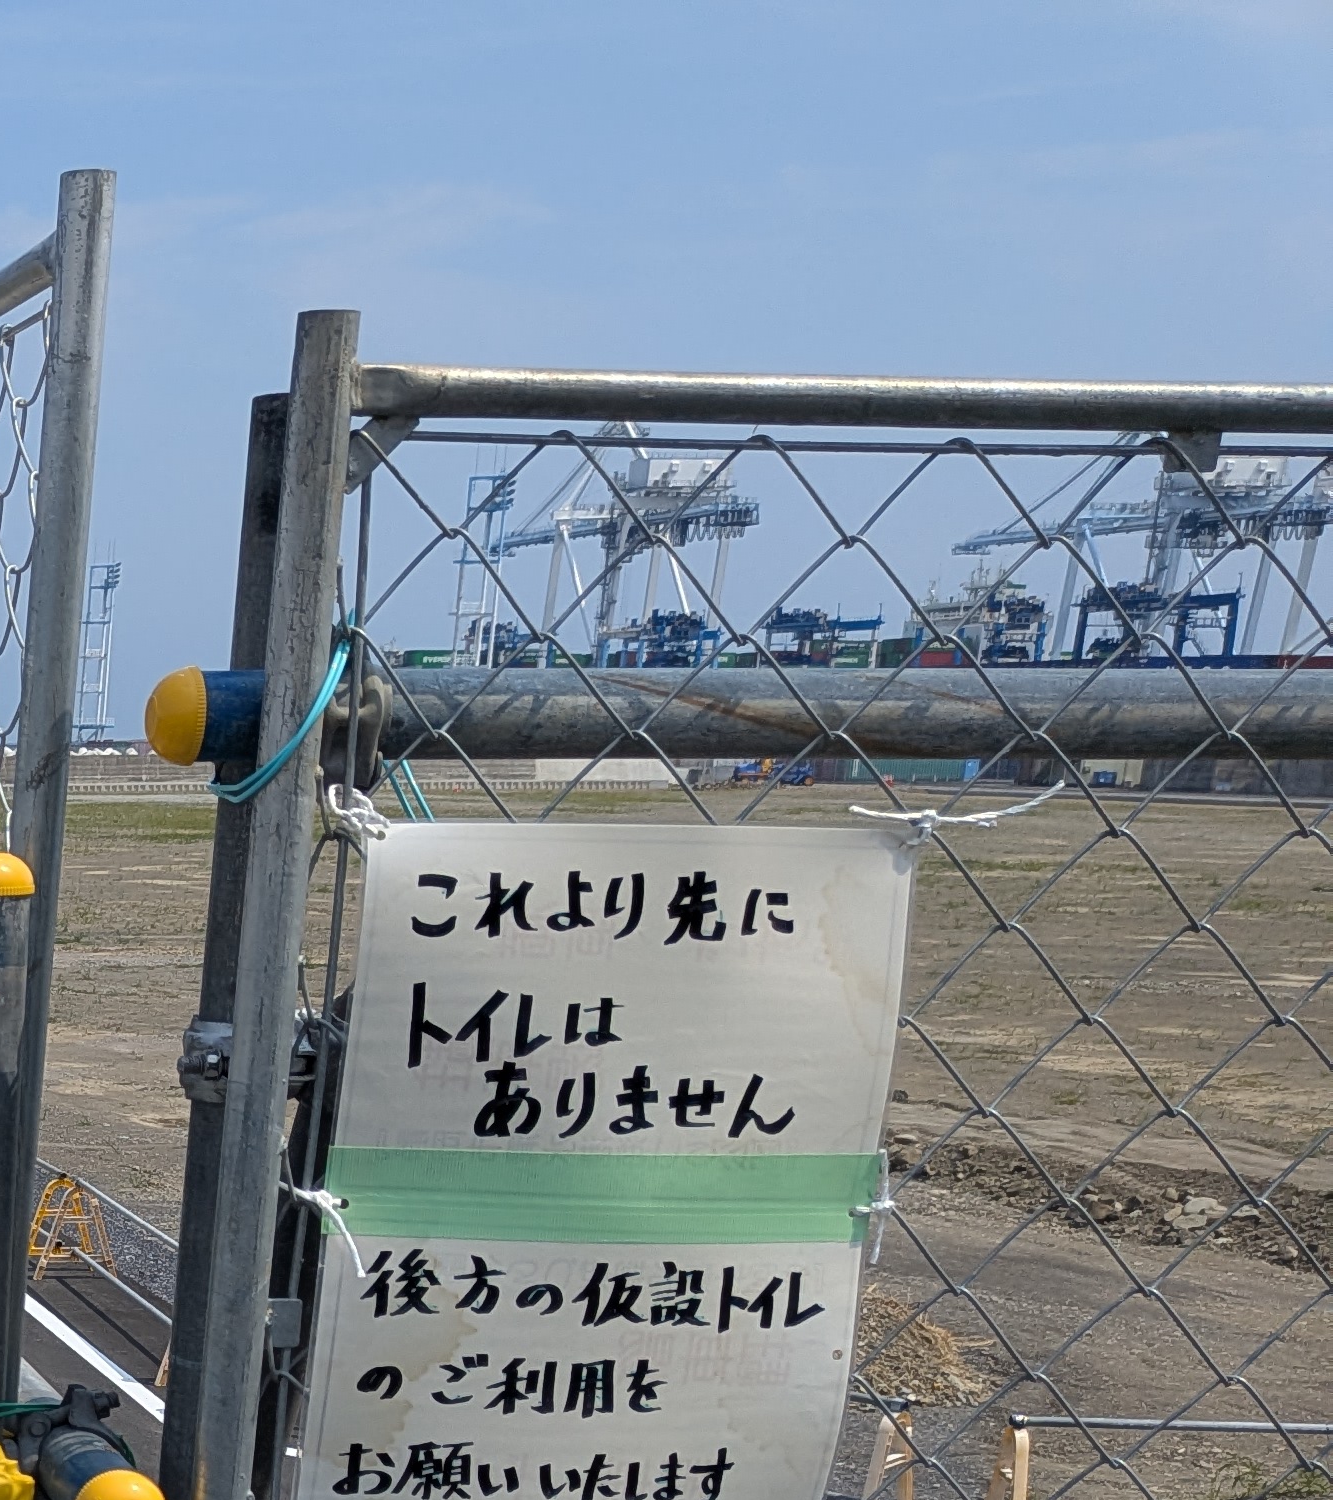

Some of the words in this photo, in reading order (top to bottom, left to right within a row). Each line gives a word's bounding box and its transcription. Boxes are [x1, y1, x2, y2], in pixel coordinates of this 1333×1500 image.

[411, 870, 795, 945] これより先に
[408, 981, 625, 1068] トイレは
[473, 1060, 795, 1139] ありません
[360, 1247, 825, 1334] 後方の仮設トイレ
[356, 1353, 668, 1418] のご利用を
